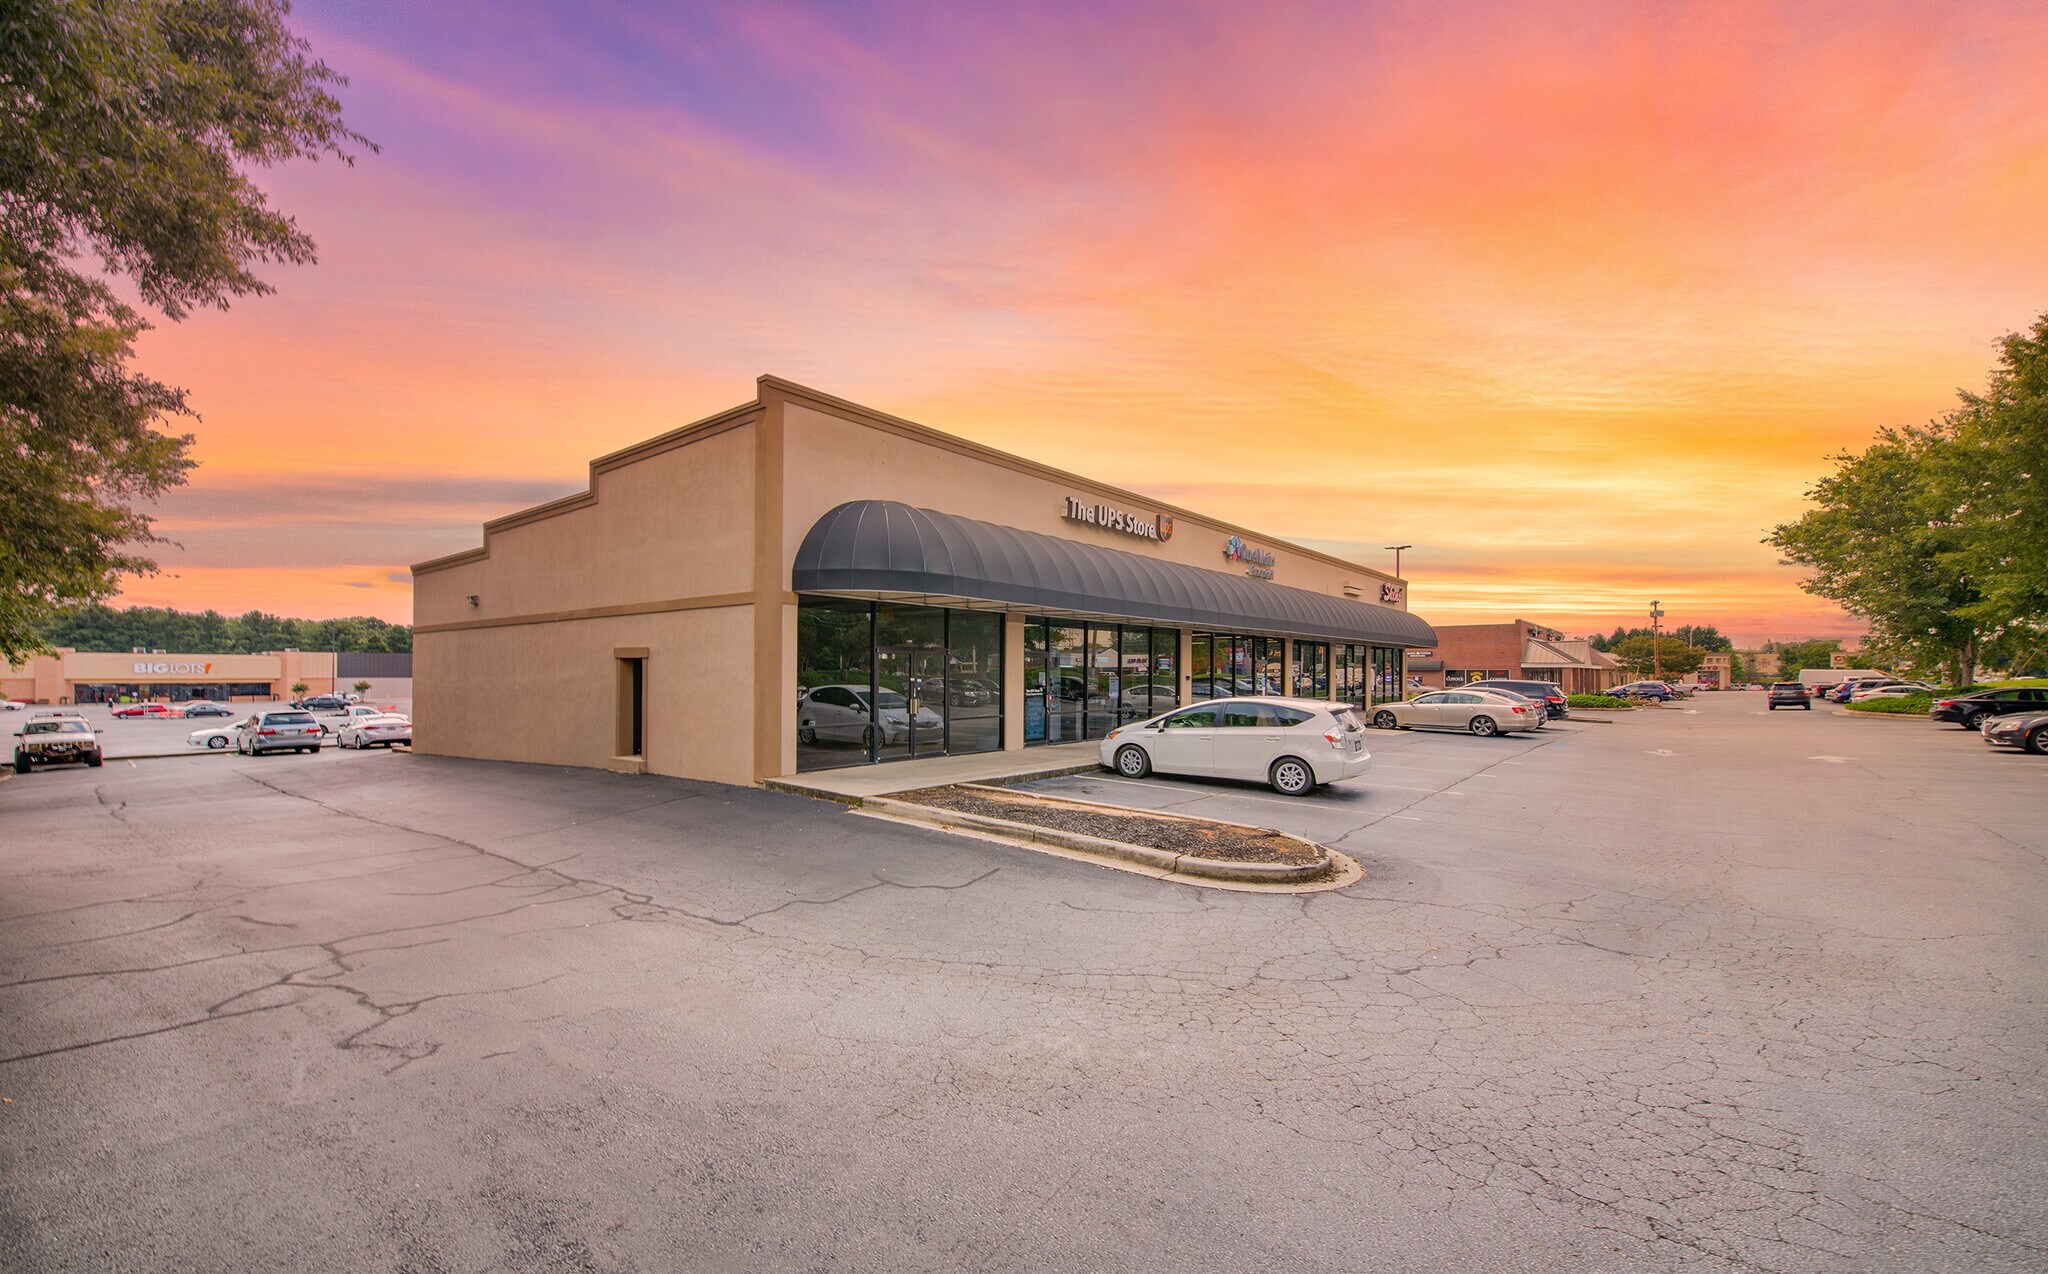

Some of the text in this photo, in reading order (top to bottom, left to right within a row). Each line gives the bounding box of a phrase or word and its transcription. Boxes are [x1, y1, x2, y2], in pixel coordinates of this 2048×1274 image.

[1068, 496, 1157, 539] The UPS Store
[133, 662, 168, 674] BIG
